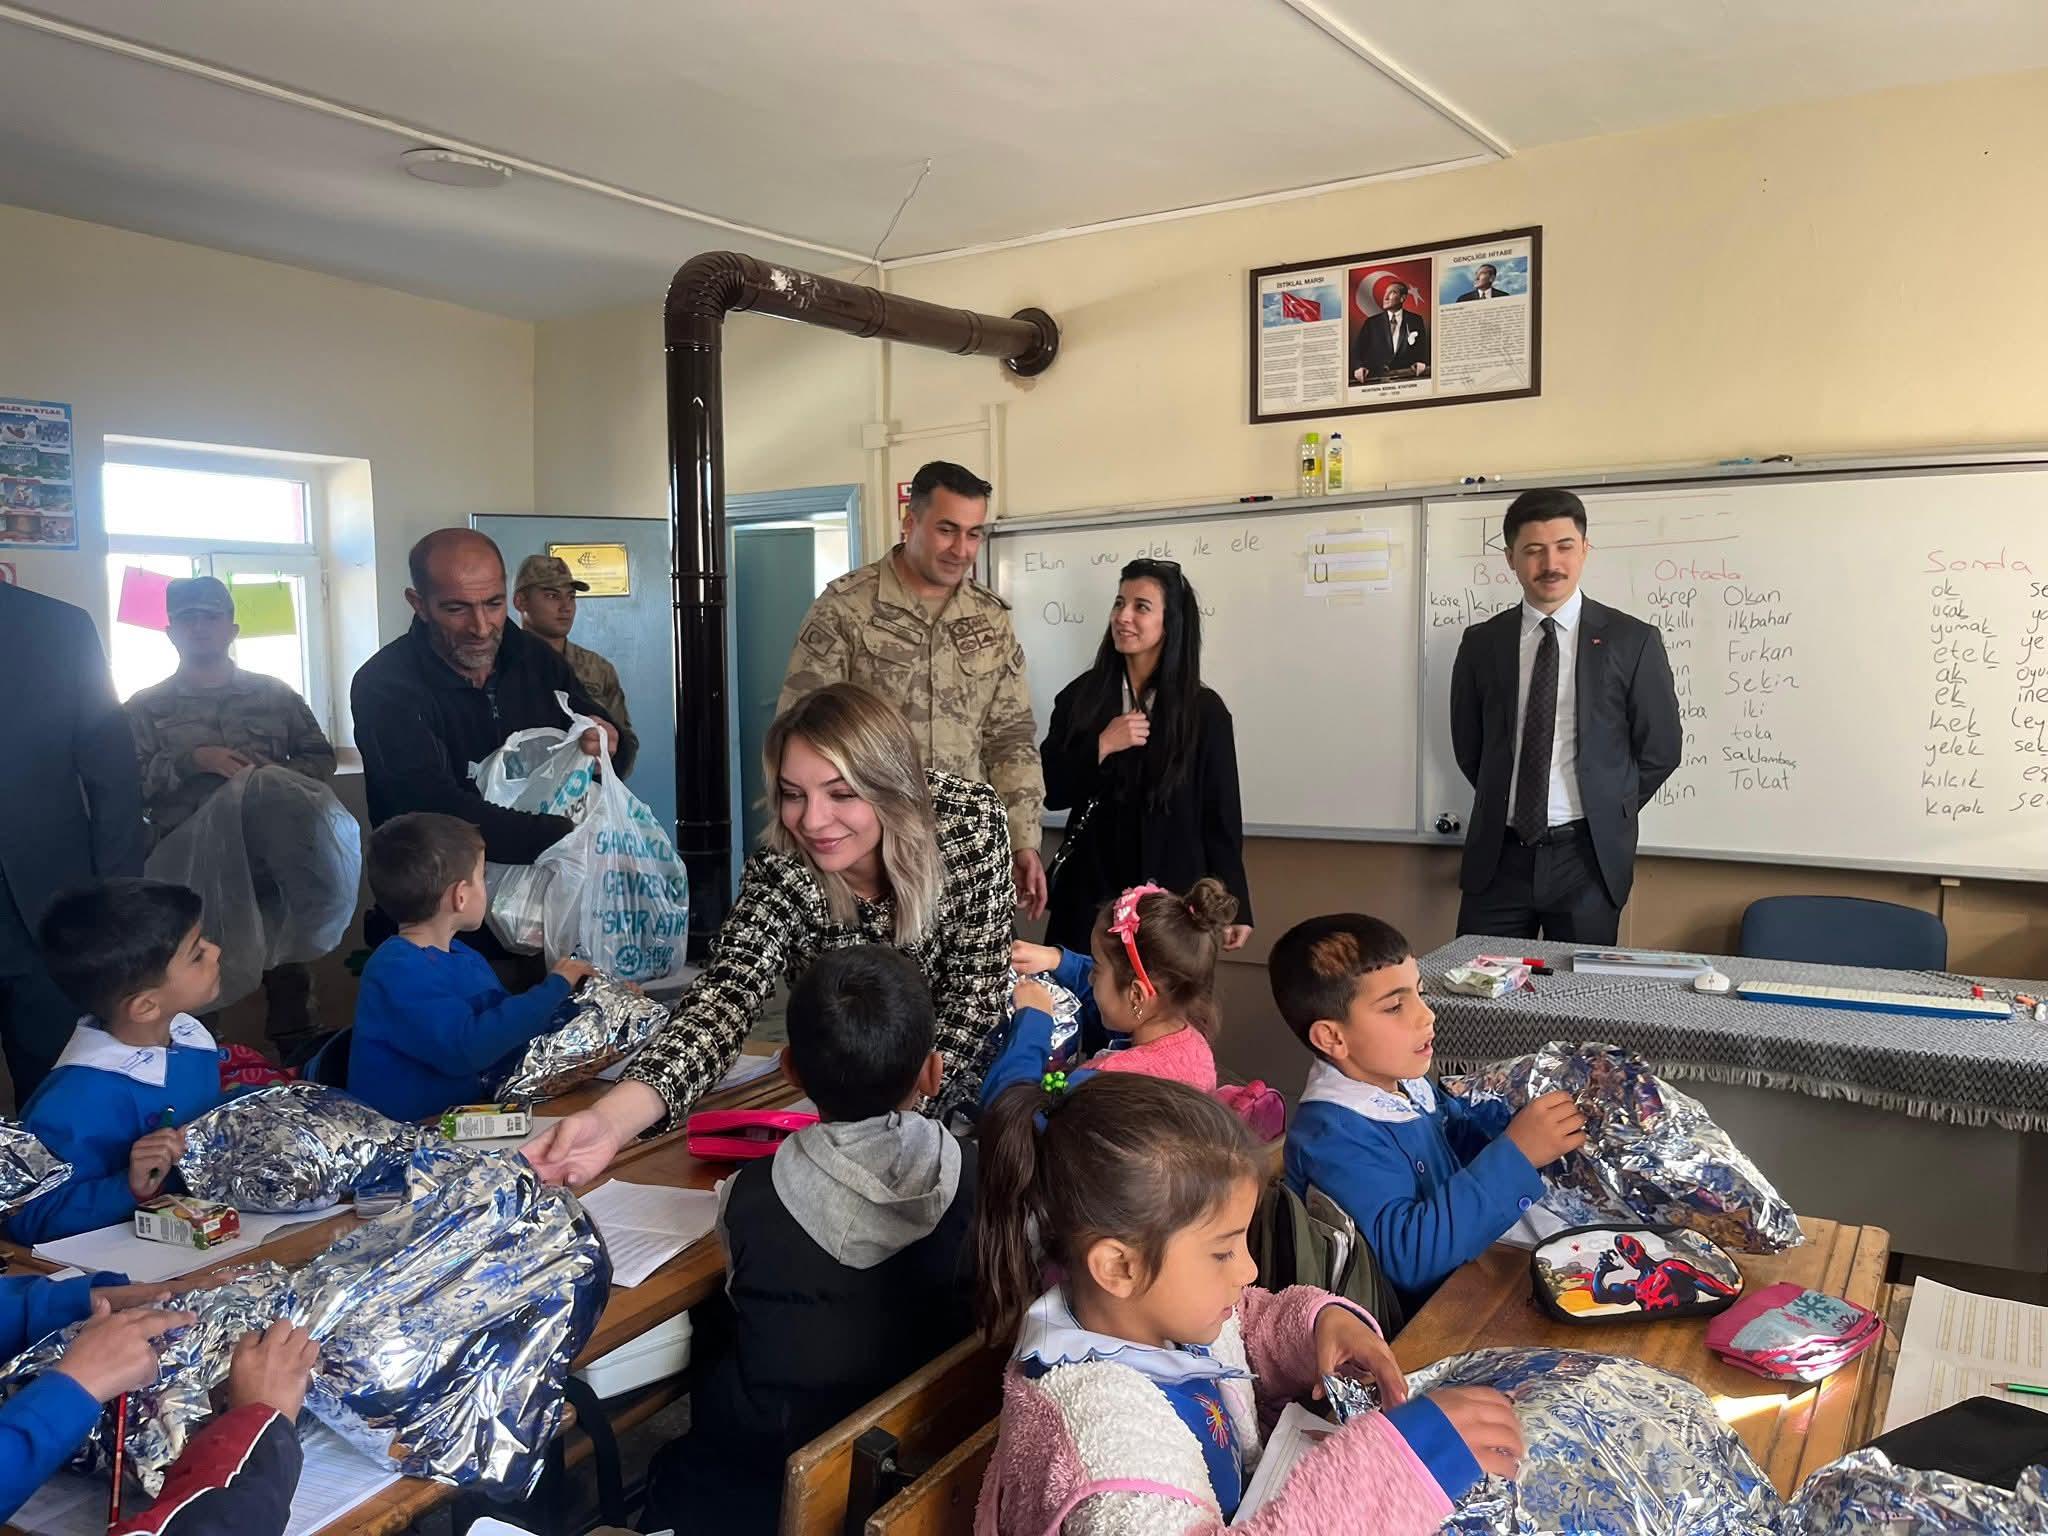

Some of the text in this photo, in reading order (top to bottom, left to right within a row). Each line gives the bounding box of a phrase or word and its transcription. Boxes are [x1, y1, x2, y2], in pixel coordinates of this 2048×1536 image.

[1231, 529, 1264, 552] ele
[1655, 558, 1743, 581] Ortada
[1922, 546, 2033, 575] Sonda
[1647, 585, 1697, 609] akrep
[1723, 584, 1781, 606] Okan
[1931, 577, 1961, 600] ok
[2029, 582, 2048, 598] se
[1042, 600, 1085, 626] Oku
[1728, 608, 1793, 632] ilkbahar
[1932, 600, 1969, 619] uçak
[1930, 617, 1998, 645] yumak
[1728, 636, 1793, 664] Furkan
[1933, 639, 2000, 668] etek
[1935, 661, 1967, 684] ak
[1935, 682, 1966, 706] ek
[2017, 686, 2048, 703] ine
[1743, 698, 1765, 718] iki
[1730, 721, 1773, 742] toka
[1929, 707, 1981, 738] kek
[1924, 735, 1985, 768] yelek
[1728, 768, 1791, 791] Tokat
[1925, 796, 1985, 821] kapak
